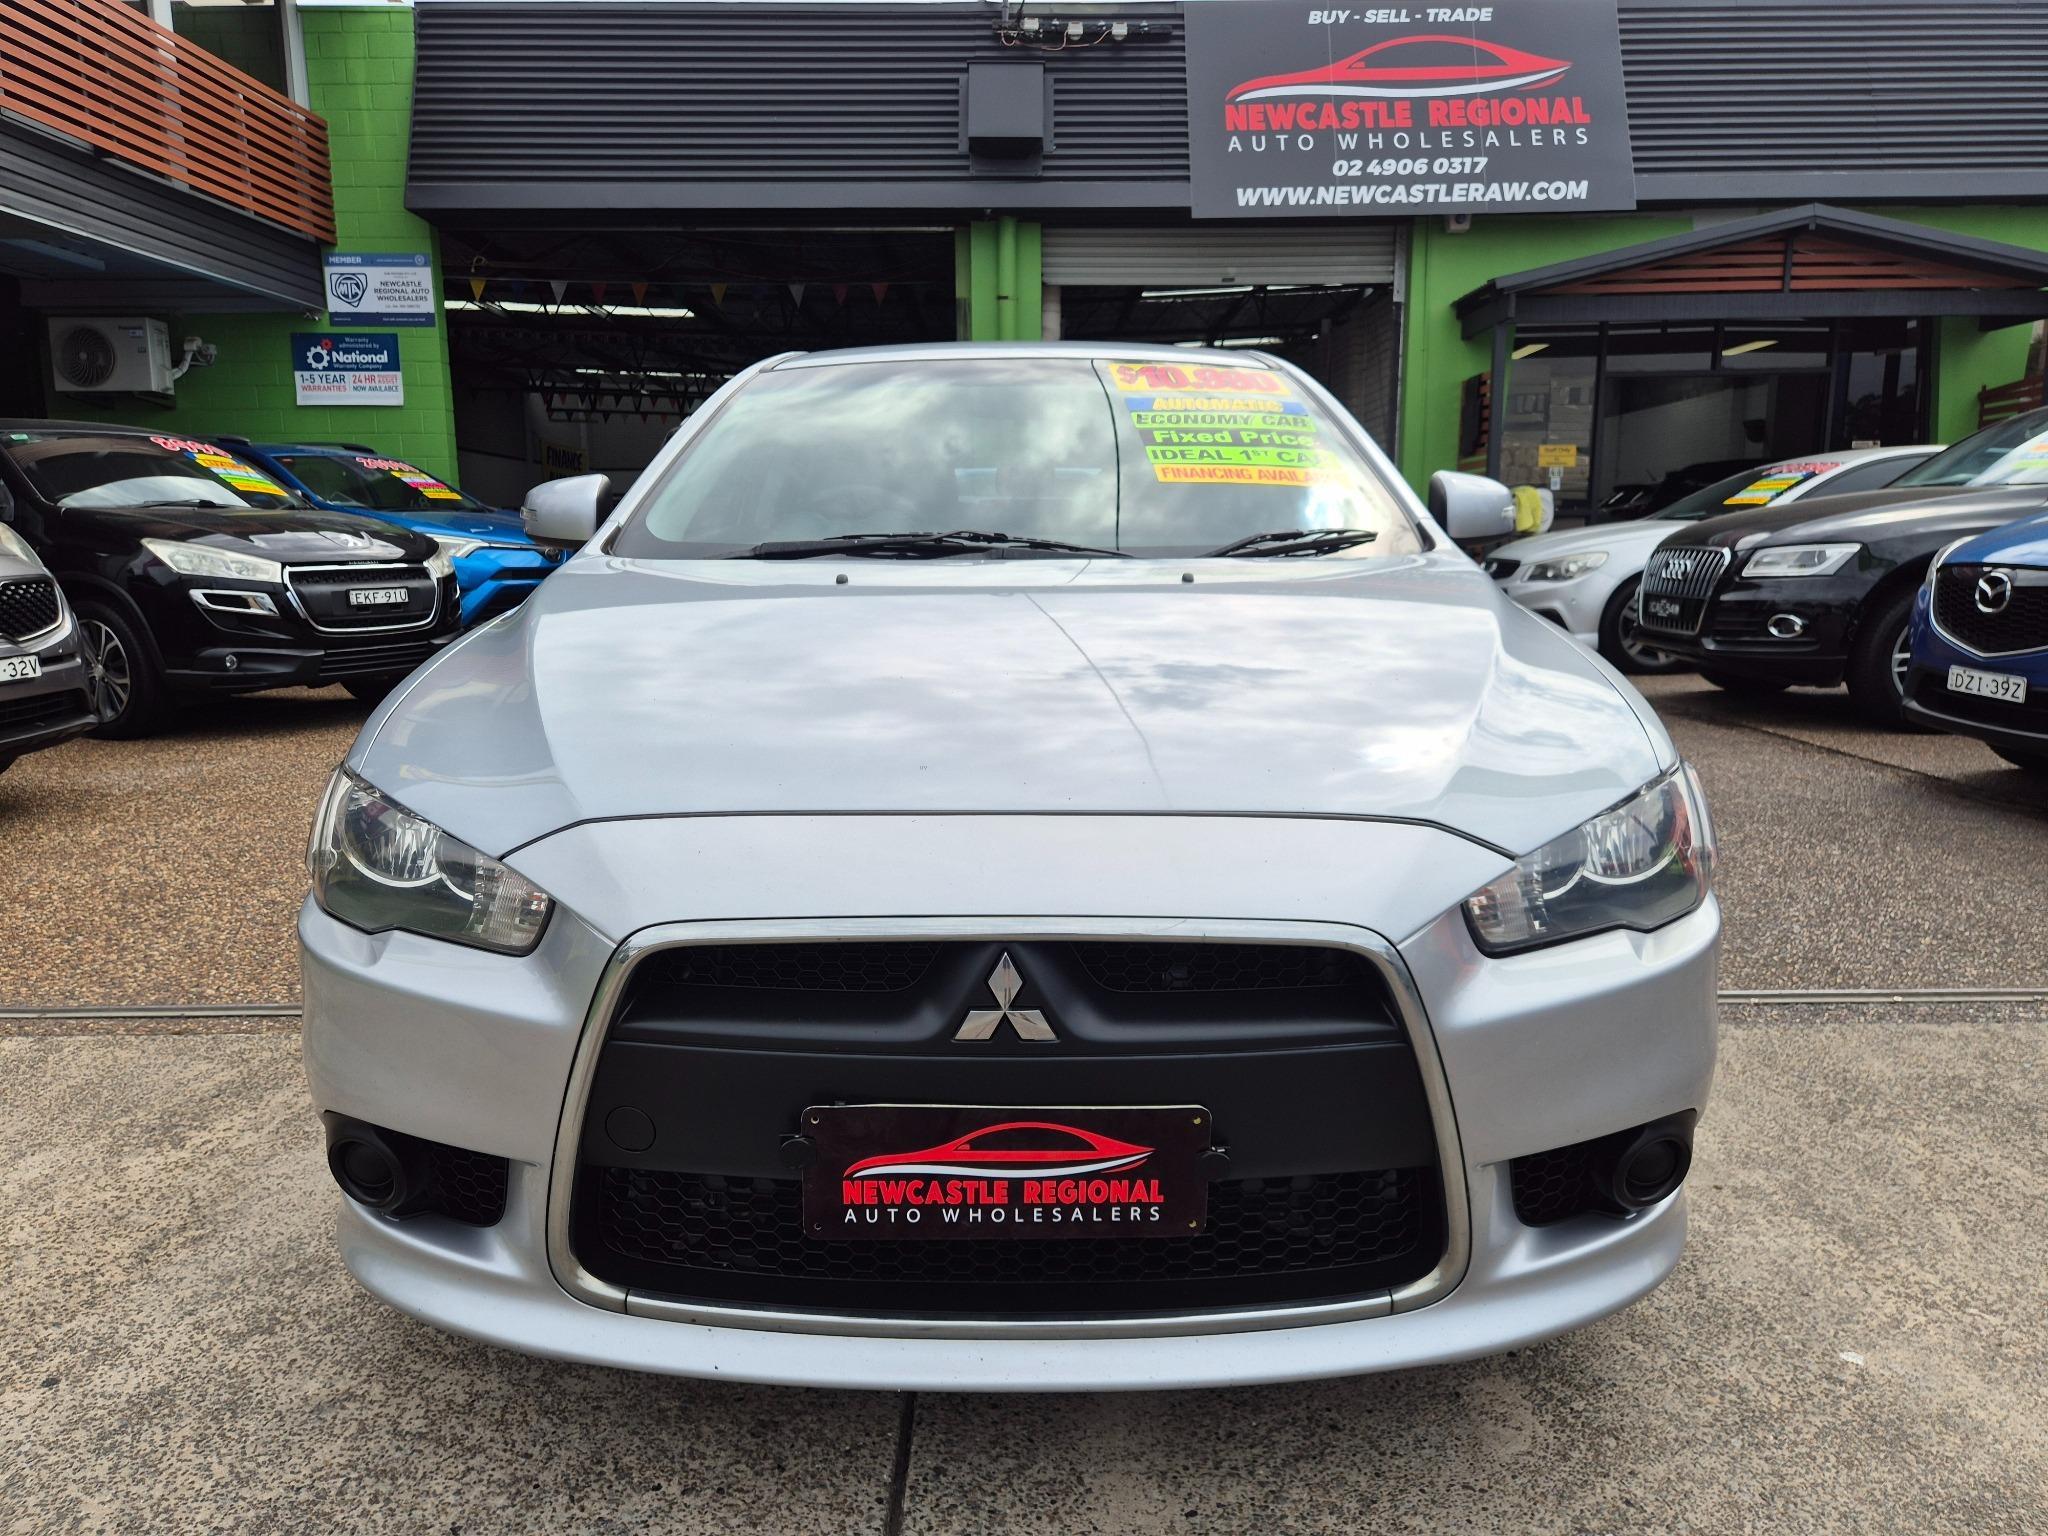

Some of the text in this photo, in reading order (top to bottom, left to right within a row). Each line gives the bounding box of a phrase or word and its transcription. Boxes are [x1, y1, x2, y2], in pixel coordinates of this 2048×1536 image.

[1308, 10, 1350, 25] BUY
[1364, 8, 1411, 23] SELL
[1426, 7, 1493, 22] TRADE
[1225, 97, 1591, 131] NEWCASTLE REGIONAL
[1228, 128, 1589, 152] AUTO WHOLESALERS
[1332, 156, 1488, 177] 02 4906 0317
[1236, 180, 1589, 207] WWW.NEWCASTLERAW.COM
[328, 256, 362, 264] MEMBER
[338, 280, 360, 299] MTA
[331, 350, 389, 363] National
[300, 374, 346, 384] 1-5 YEAR
[352, 375, 363, 384] 24
[364, 375, 376, 384] HR
[1152, 397, 1284, 413] AUTOMATIC
[1136, 413, 1309, 428] ECONOMY CAR
[1152, 430, 1314, 447] Fixed Price
[547, 446, 582, 472] FINANCE
[1151, 449, 1233, 461] IDEAL
[1161, 467, 1251, 480] FINANCING
[842, 1179, 1164, 1205] NEWCASTLE REGIONAL
[844, 1206, 1160, 1223] AUTO WHOLESALERS
